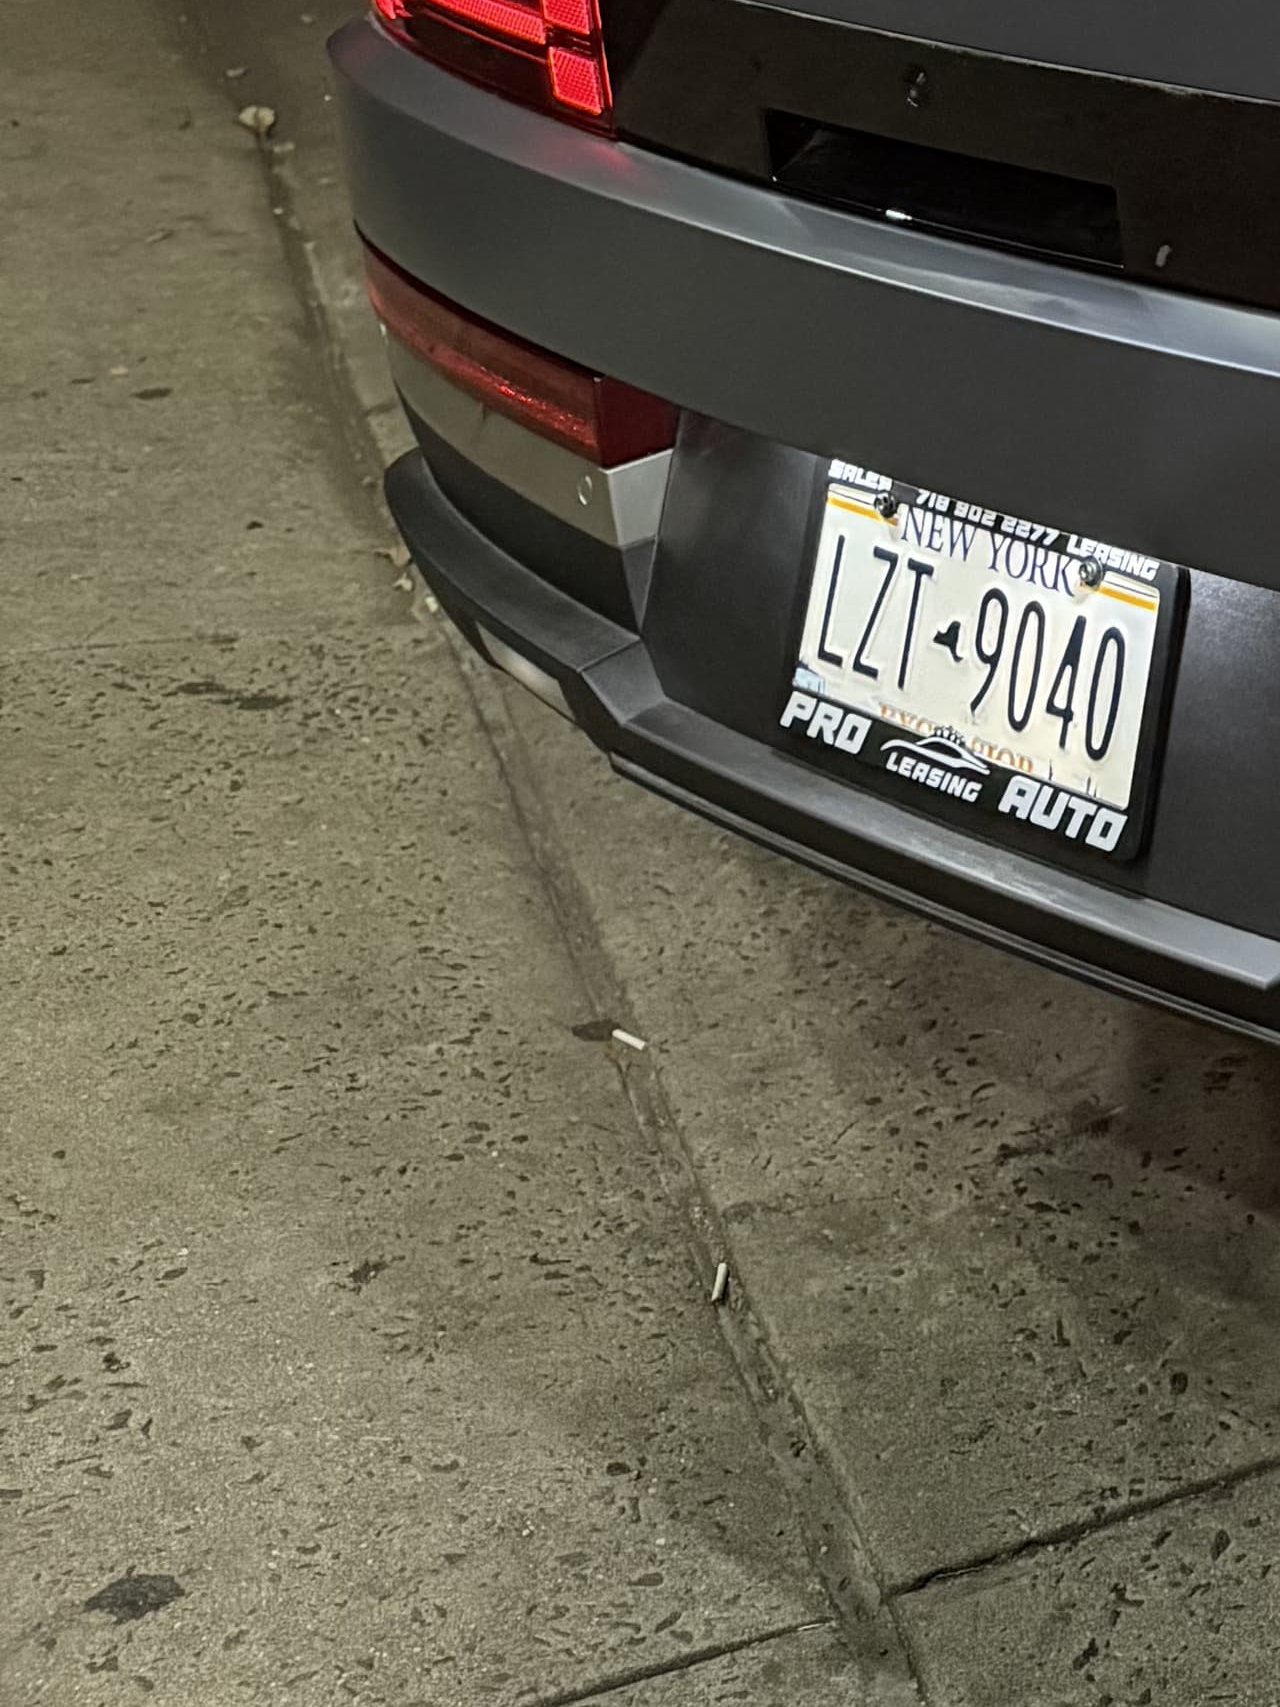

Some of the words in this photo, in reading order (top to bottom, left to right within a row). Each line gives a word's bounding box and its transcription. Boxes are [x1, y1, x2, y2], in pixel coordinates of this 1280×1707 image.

[901, 506, 977, 563] NEW
[987, 530, 1077, 596] YORK
[915, 488, 950, 512] 718
[1001, 514, 1061, 546] 2277
[1067, 534, 1160, 580] LEASING
[817, 534, 935, 691] LZT
[970, 588, 1127, 762] 9040
[780, 690, 872, 756] PRO
[885, 751, 983, 803] LEASING
[998, 774, 1128, 853] AUTO
